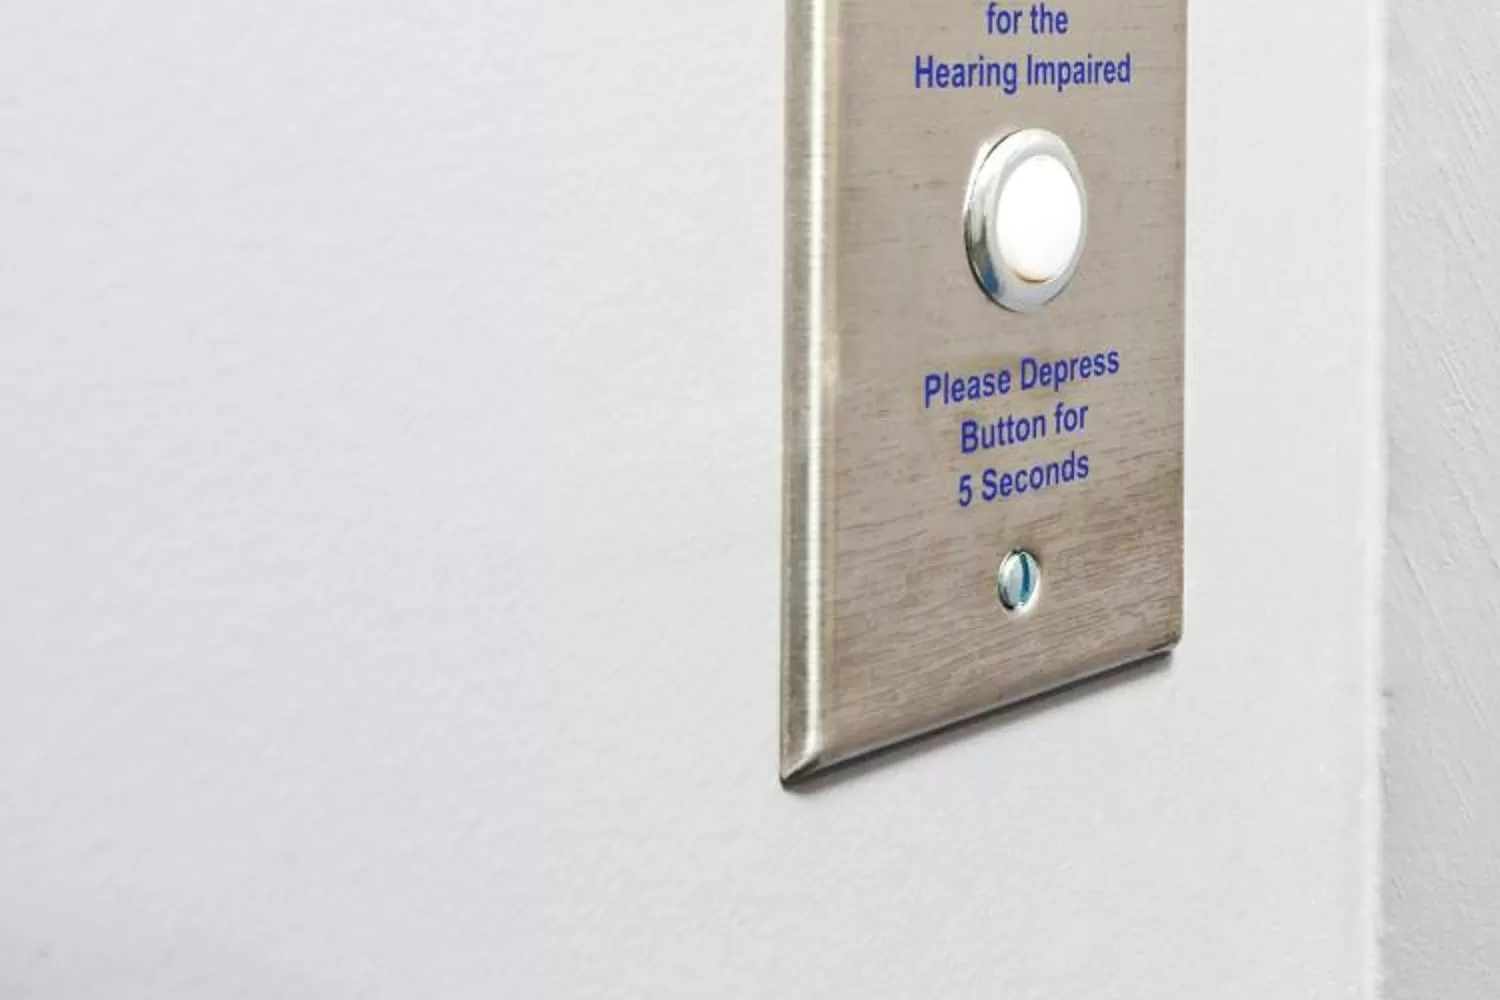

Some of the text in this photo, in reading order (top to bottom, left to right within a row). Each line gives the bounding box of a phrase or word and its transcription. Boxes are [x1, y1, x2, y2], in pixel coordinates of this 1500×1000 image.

[985, 2, 1069, 34] for the
[913, 53, 1133, 95] Hearing Impaired
[924, 349, 1120, 408] Please Depress
[960, 402, 1089, 454] Button for
[958, 450, 1090, 506] 5 Seconds
